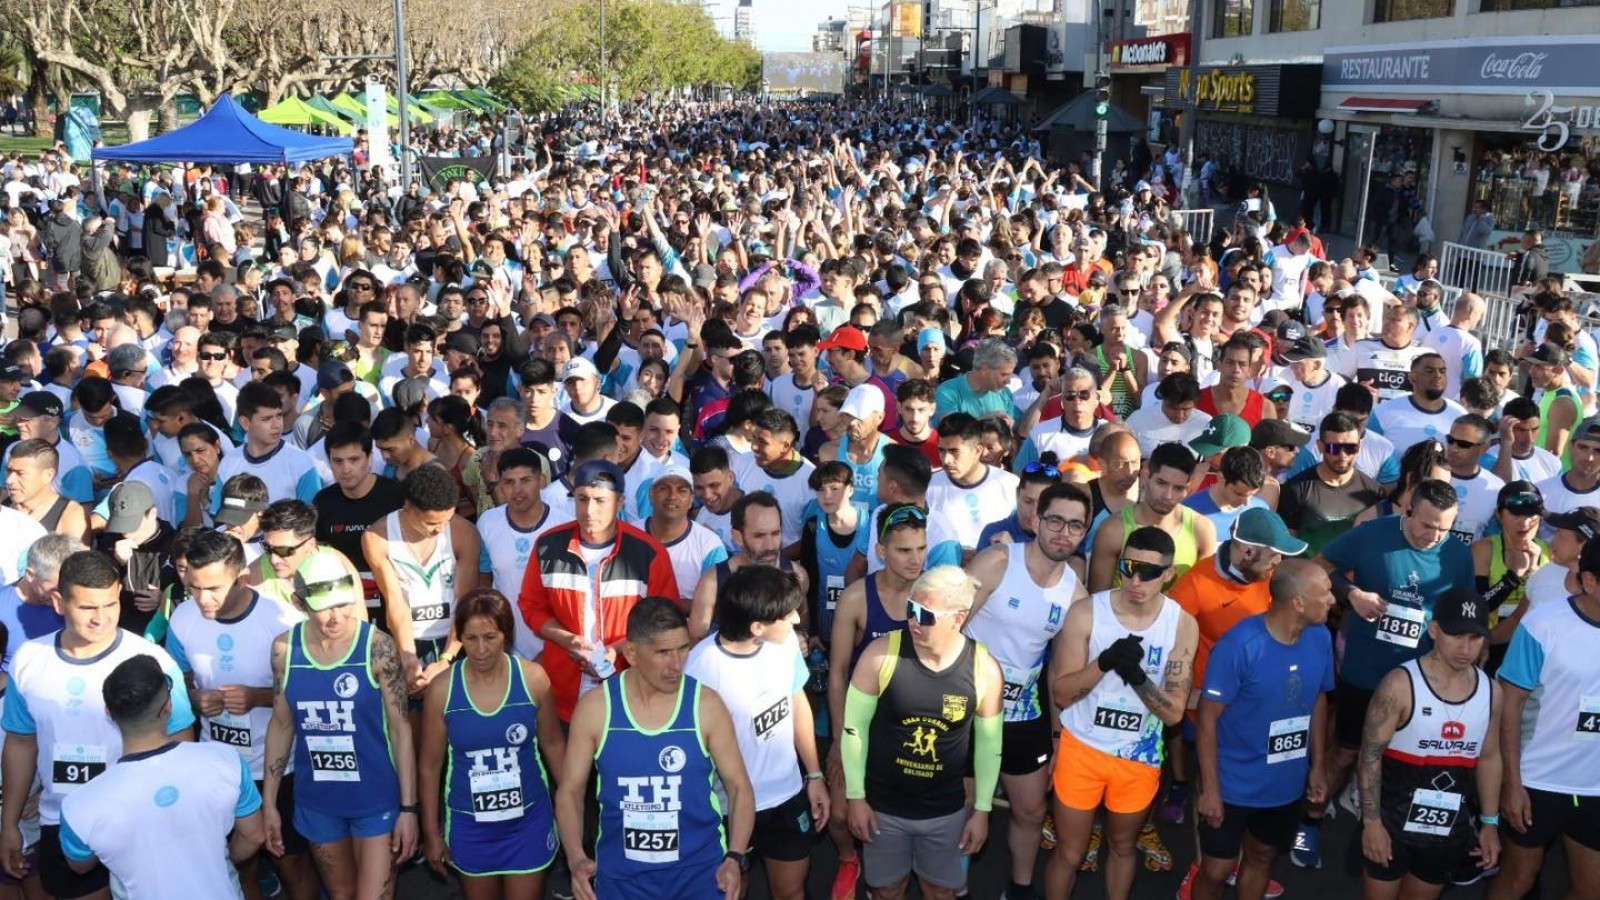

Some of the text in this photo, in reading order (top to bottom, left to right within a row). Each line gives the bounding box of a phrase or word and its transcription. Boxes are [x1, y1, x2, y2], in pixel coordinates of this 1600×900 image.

[1121, 41, 1166, 64] McDonald's
[1340, 55, 1430, 80] RESTAURANTE
[1178, 68, 1254, 110] Mga Sports
[1520, 89, 1577, 152] 25
[416, 605, 444, 620] 208
[1381, 617, 1420, 638] 1818
[296, 701, 357, 732] TH
[756, 699, 789, 733] 1275
[1098, 710, 1140, 730] 1162
[211, 725, 250, 745] 1729
[1274, 733, 1302, 752] 865
[1417, 739, 1478, 752] SALVAJE
[313, 753, 356, 769] 1256
[464, 746, 521, 773] TH
[66, 764, 90, 782] 91
[475, 790, 521, 811] 1258
[617, 775, 682, 811] TH
[1414, 807, 1450, 825] 253
[626, 831, 677, 850] 1257
